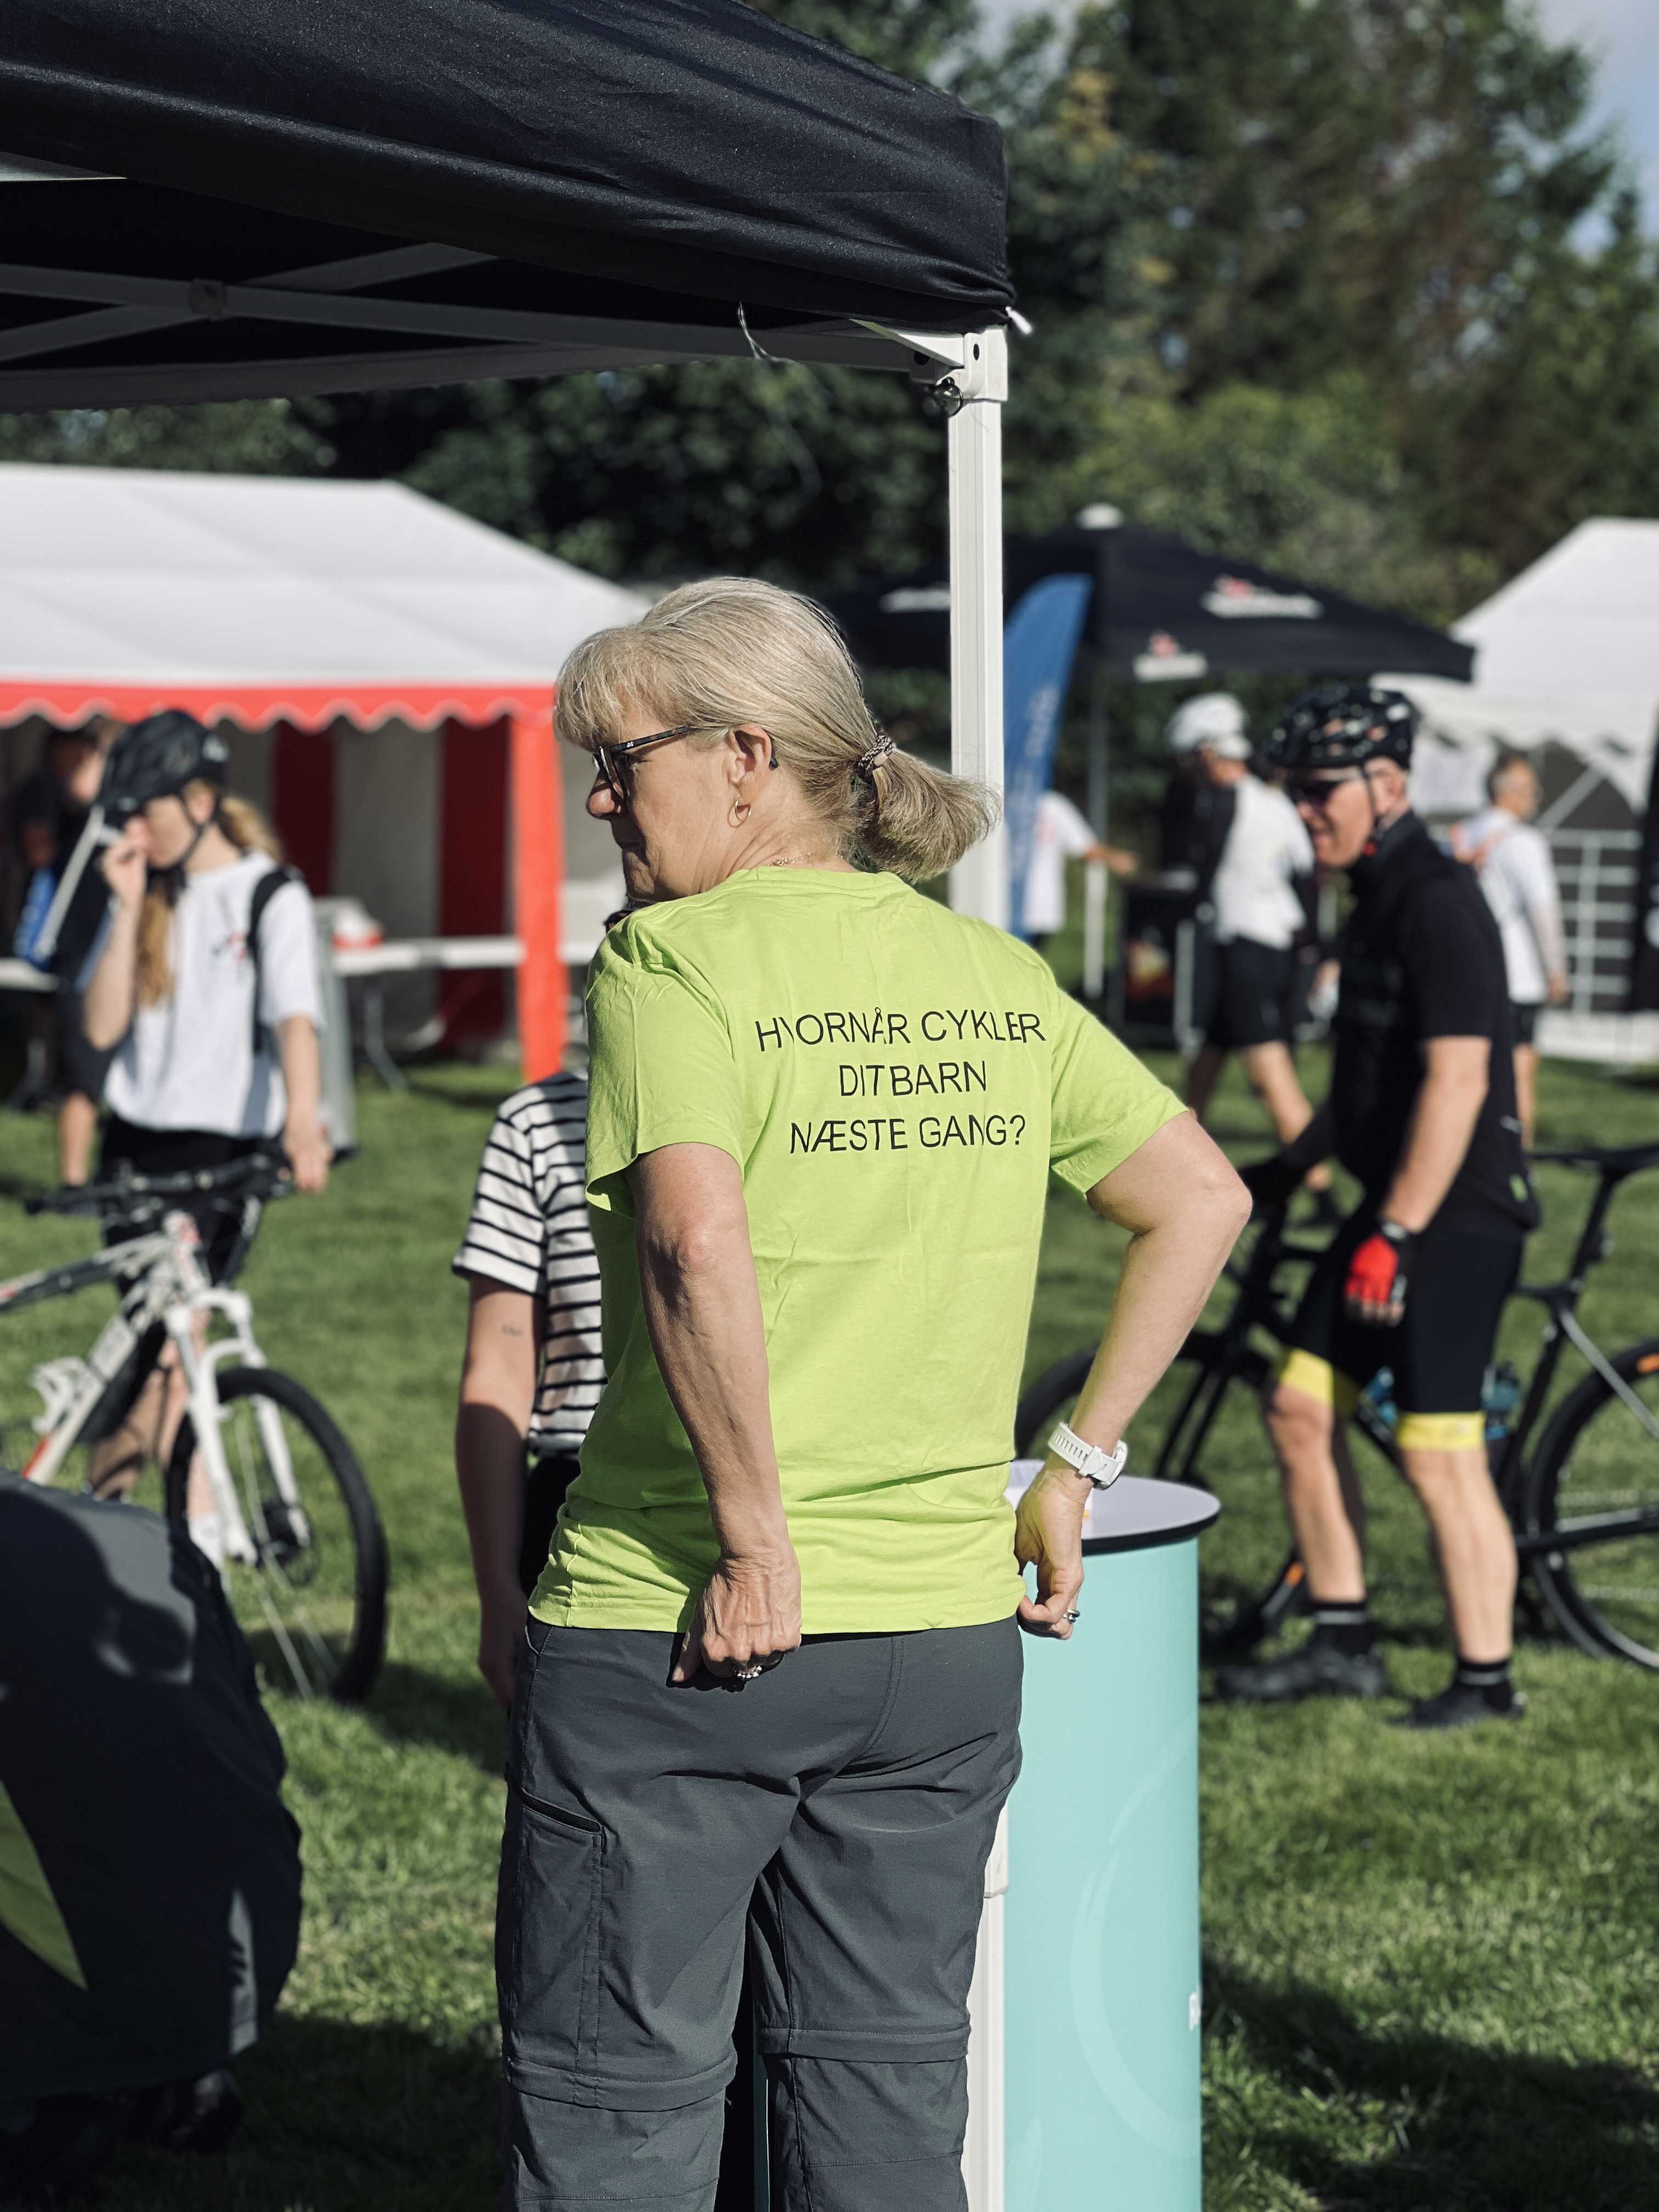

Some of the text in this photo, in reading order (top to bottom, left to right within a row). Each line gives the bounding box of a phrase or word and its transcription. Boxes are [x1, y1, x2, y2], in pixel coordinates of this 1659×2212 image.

[921, 1009, 1046, 1043] CYKLER
[839, 1060, 986, 1096] DIT BARN
[790, 1114, 1025, 1154] NÆSTE GANG?
